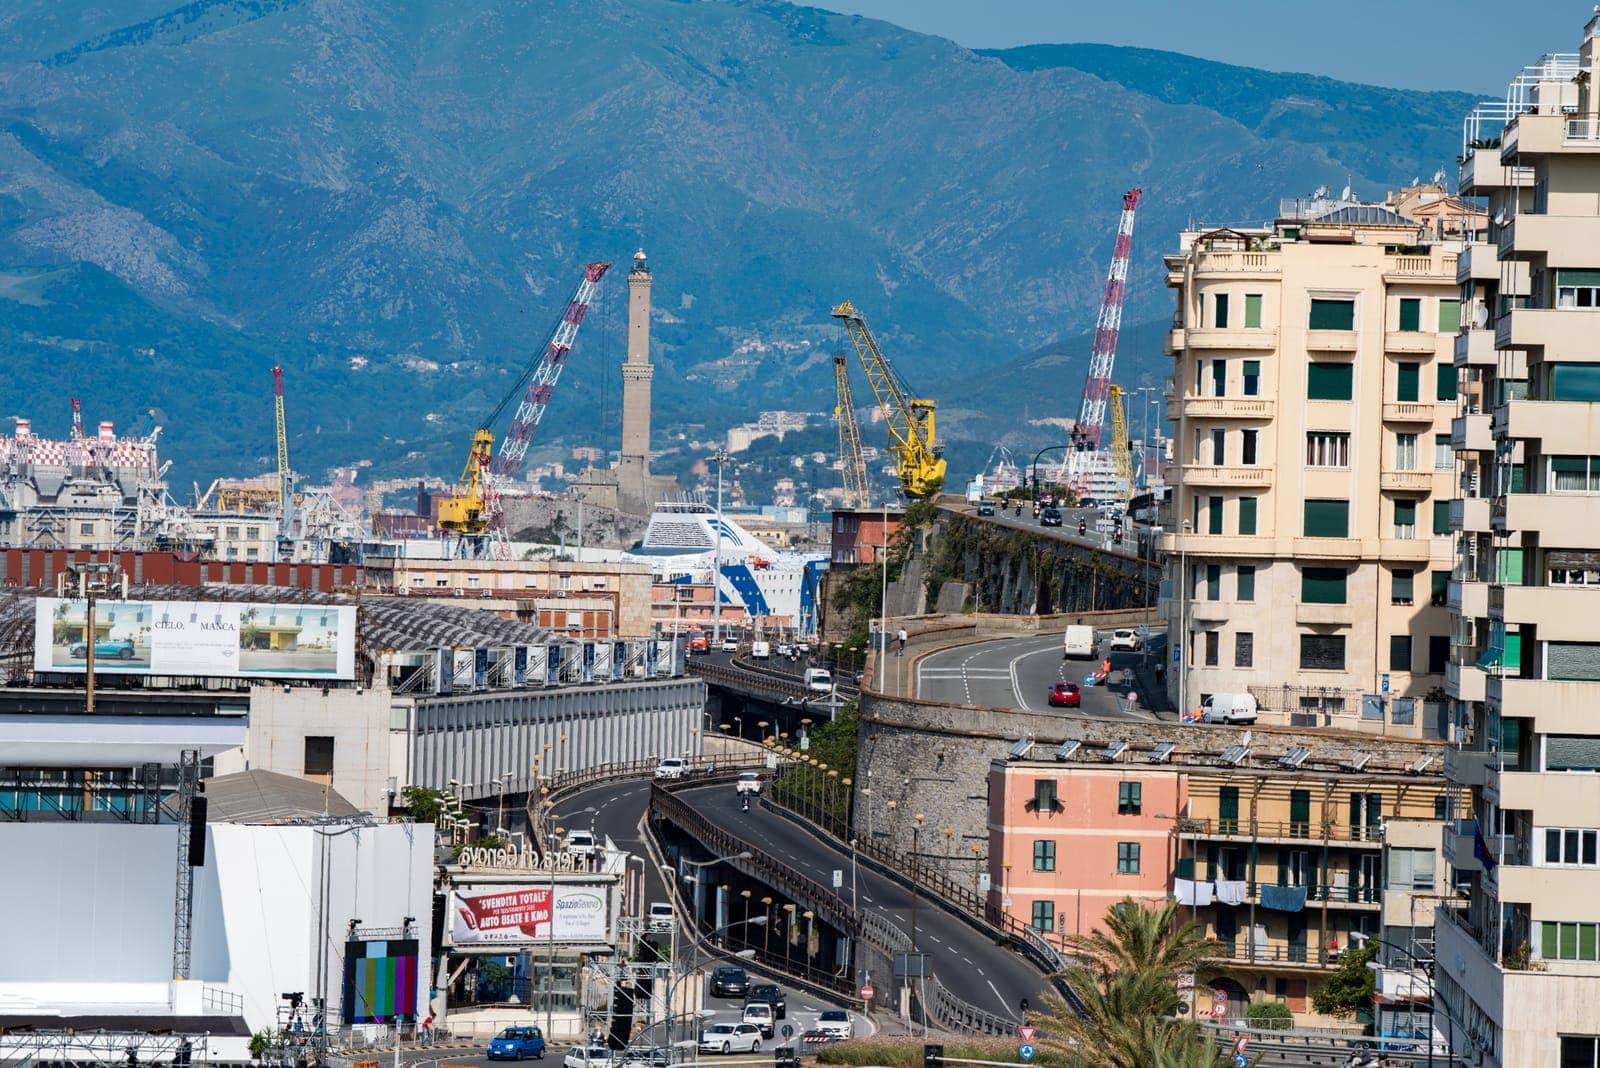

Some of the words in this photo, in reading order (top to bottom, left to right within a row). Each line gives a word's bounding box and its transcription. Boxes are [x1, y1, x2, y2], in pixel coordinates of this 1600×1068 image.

[154, 621, 185, 630] CIELO.
[480, 915, 499, 929] AUTO
[501, 914, 523, 926] USATE
[524, 912, 530, 922] E
